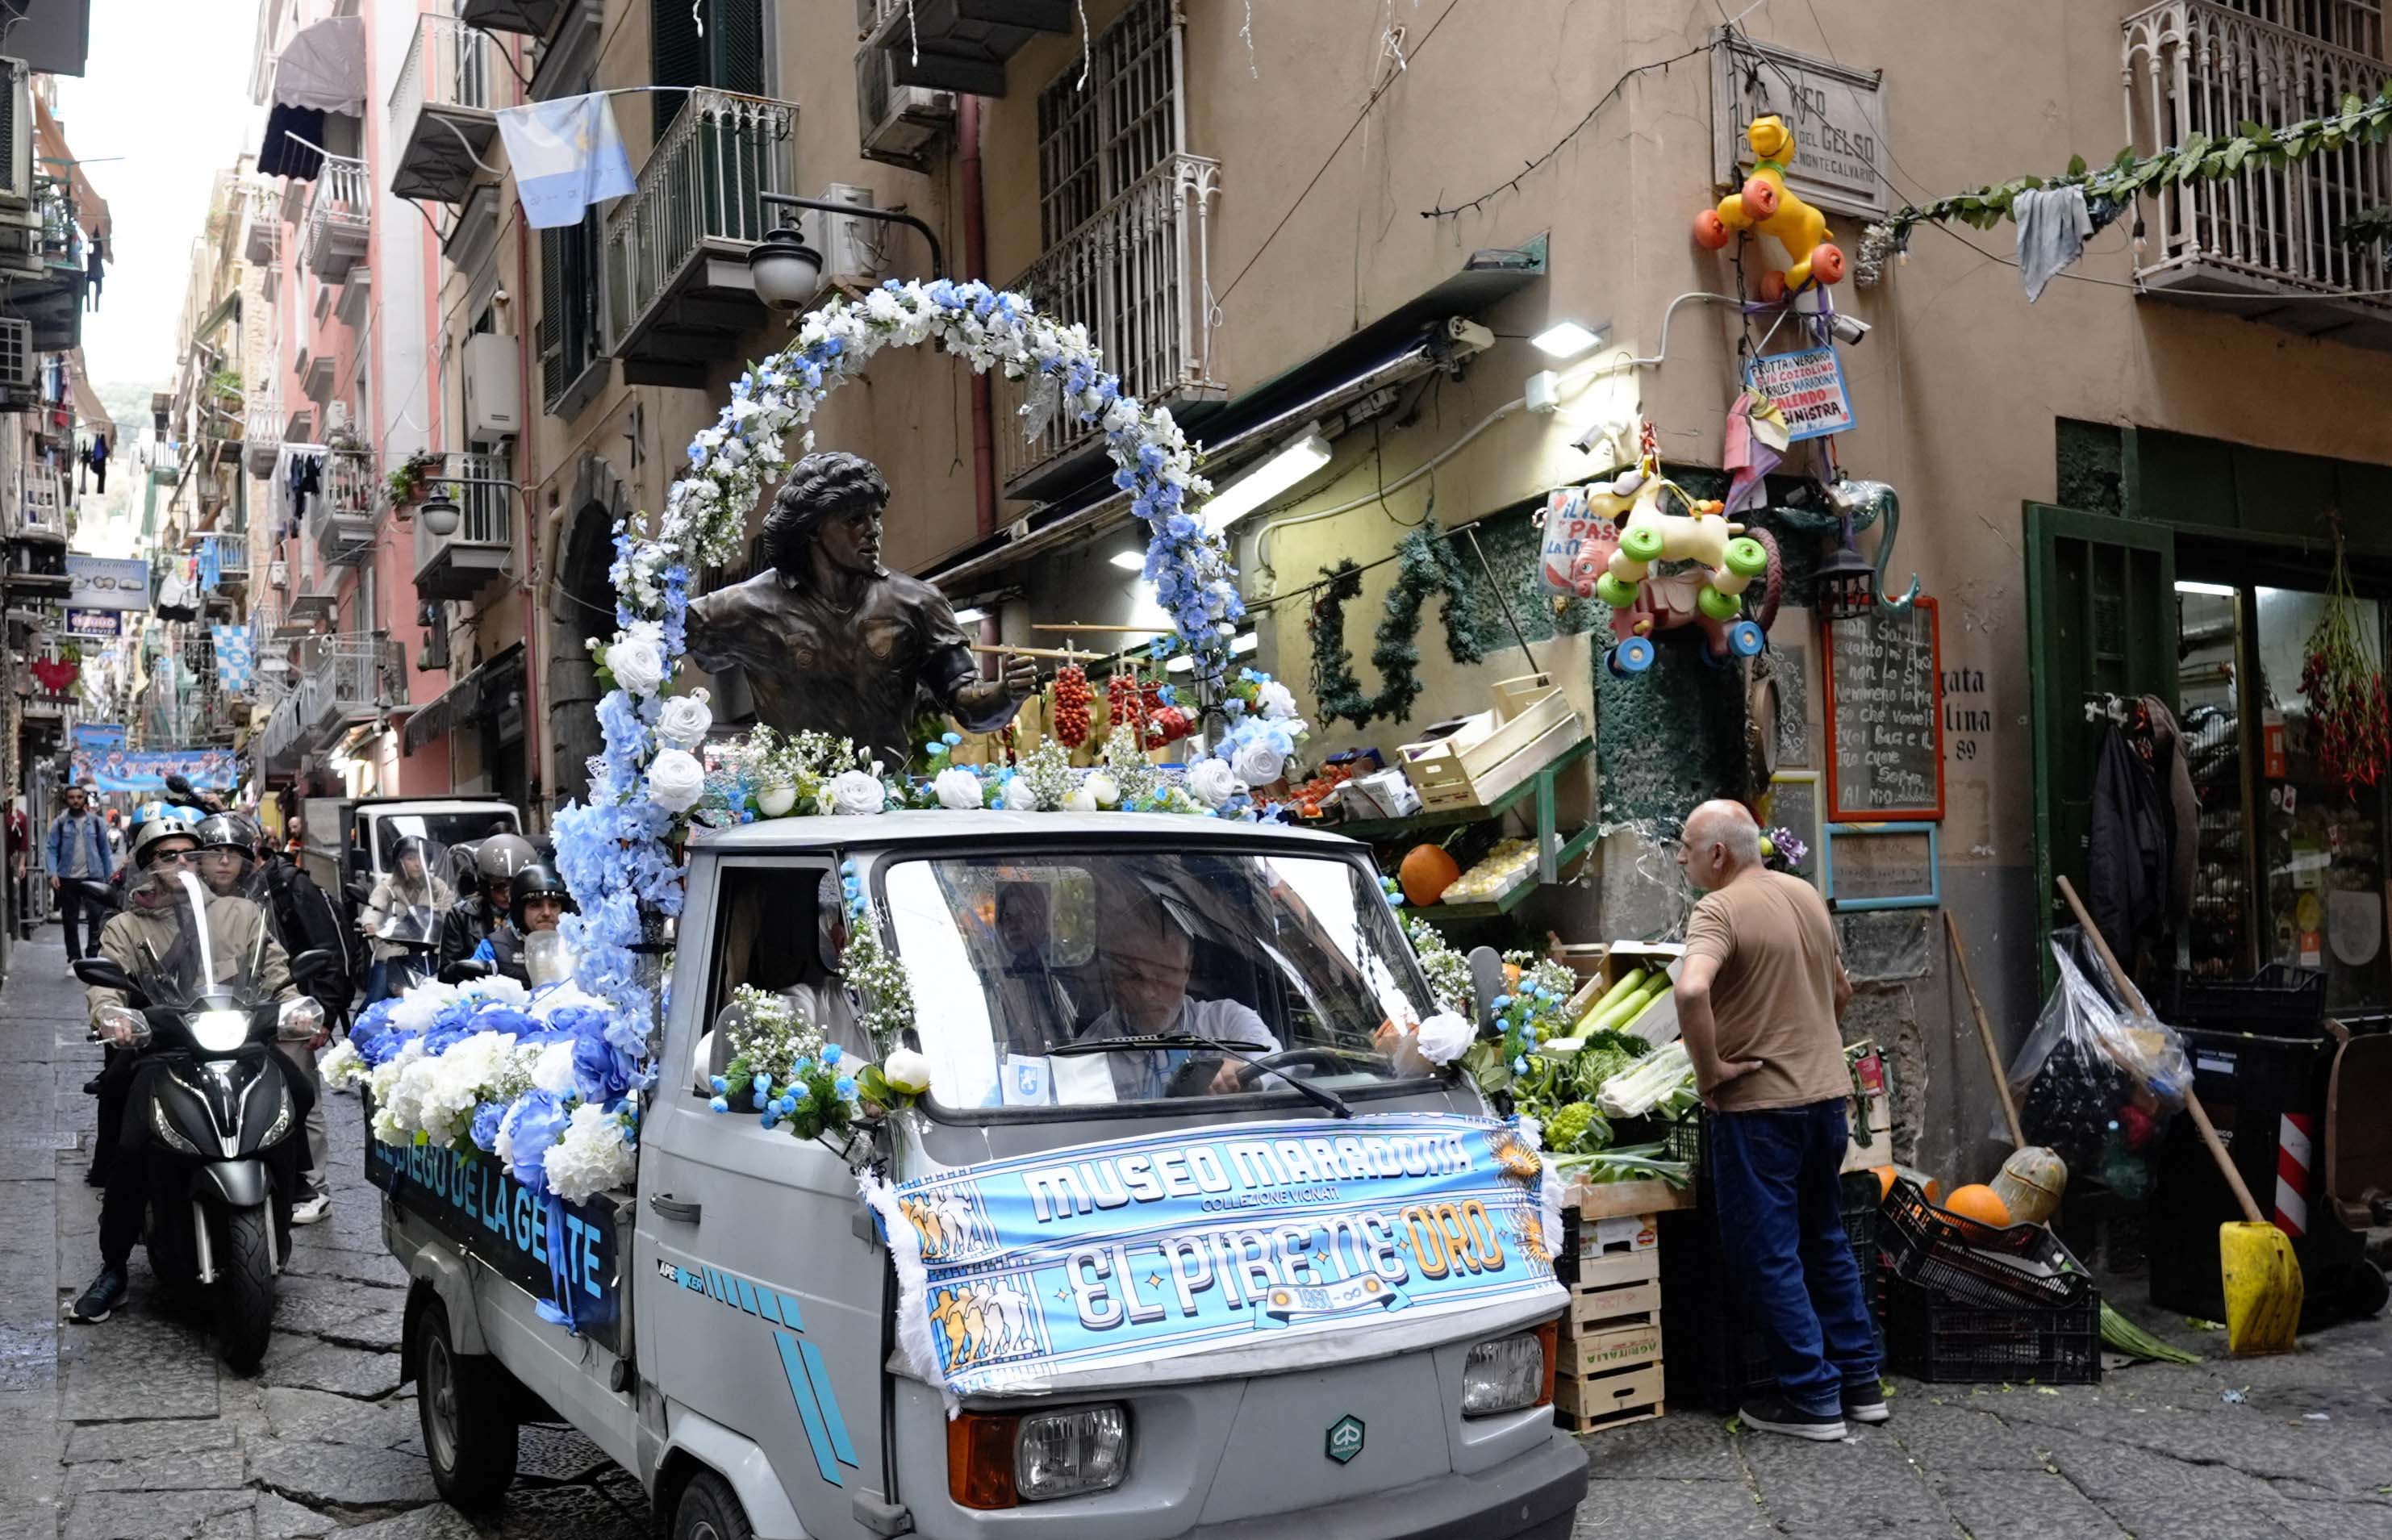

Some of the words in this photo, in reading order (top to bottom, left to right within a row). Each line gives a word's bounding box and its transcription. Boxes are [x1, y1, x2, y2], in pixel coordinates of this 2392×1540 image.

[1789, 83, 1826, 116] VICO
[1799, 131, 1818, 148] DEL
[1822, 125, 1874, 161] GELSO
[1799, 152, 1875, 184] MONTECALVARIO
[1780, 361, 1835, 382] COZZOLINO
[1956, 741, 1976, 760] 89
[1021, 1146, 1232, 1224] MUSEO
[1224, 1133, 1478, 1190] MARADONA
[1201, 1192, 1288, 1212] COLLEZIONE
[1290, 1186, 1341, 1204] VIGNATI
[450, 1149, 478, 1220] DE
[482, 1166, 511, 1241] LA
[514, 1187, 602, 1300] GETE
[660, 1261, 678, 1280] APE
[1065, 1244, 1165, 1332] EL
[1158, 1223, 1323, 1318] PIBE
[1398, 1199, 1506, 1283] ORO
[1586, 1342, 1657, 1364] AGRITALIA
